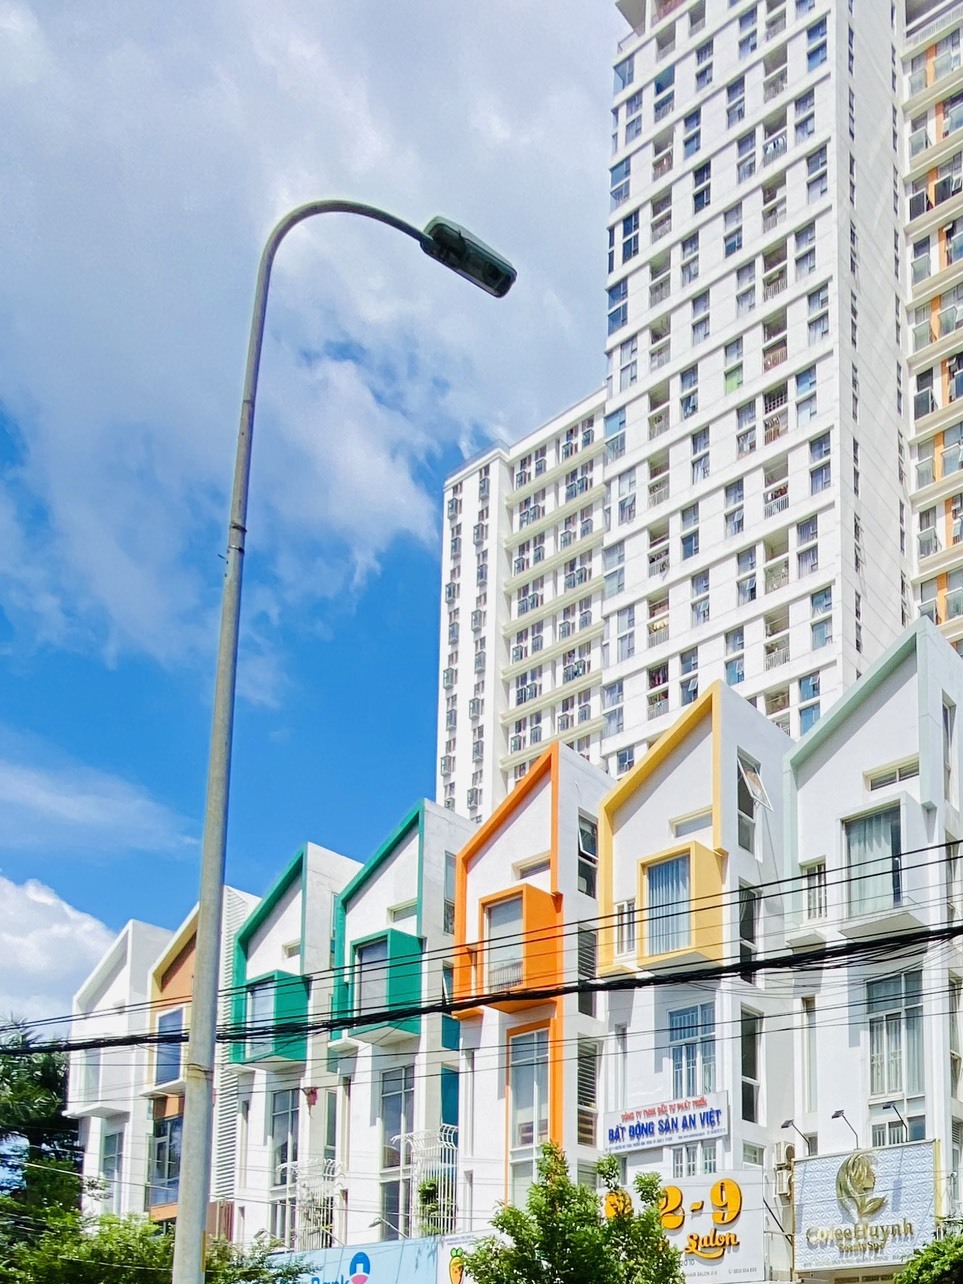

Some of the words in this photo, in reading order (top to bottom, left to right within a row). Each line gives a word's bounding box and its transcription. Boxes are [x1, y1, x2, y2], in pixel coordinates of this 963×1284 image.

[682, 1114, 698, 1130] AN
[699, 1107, 722, 1128] VIỆT
[684, 1228, 740, 1260] Salon
